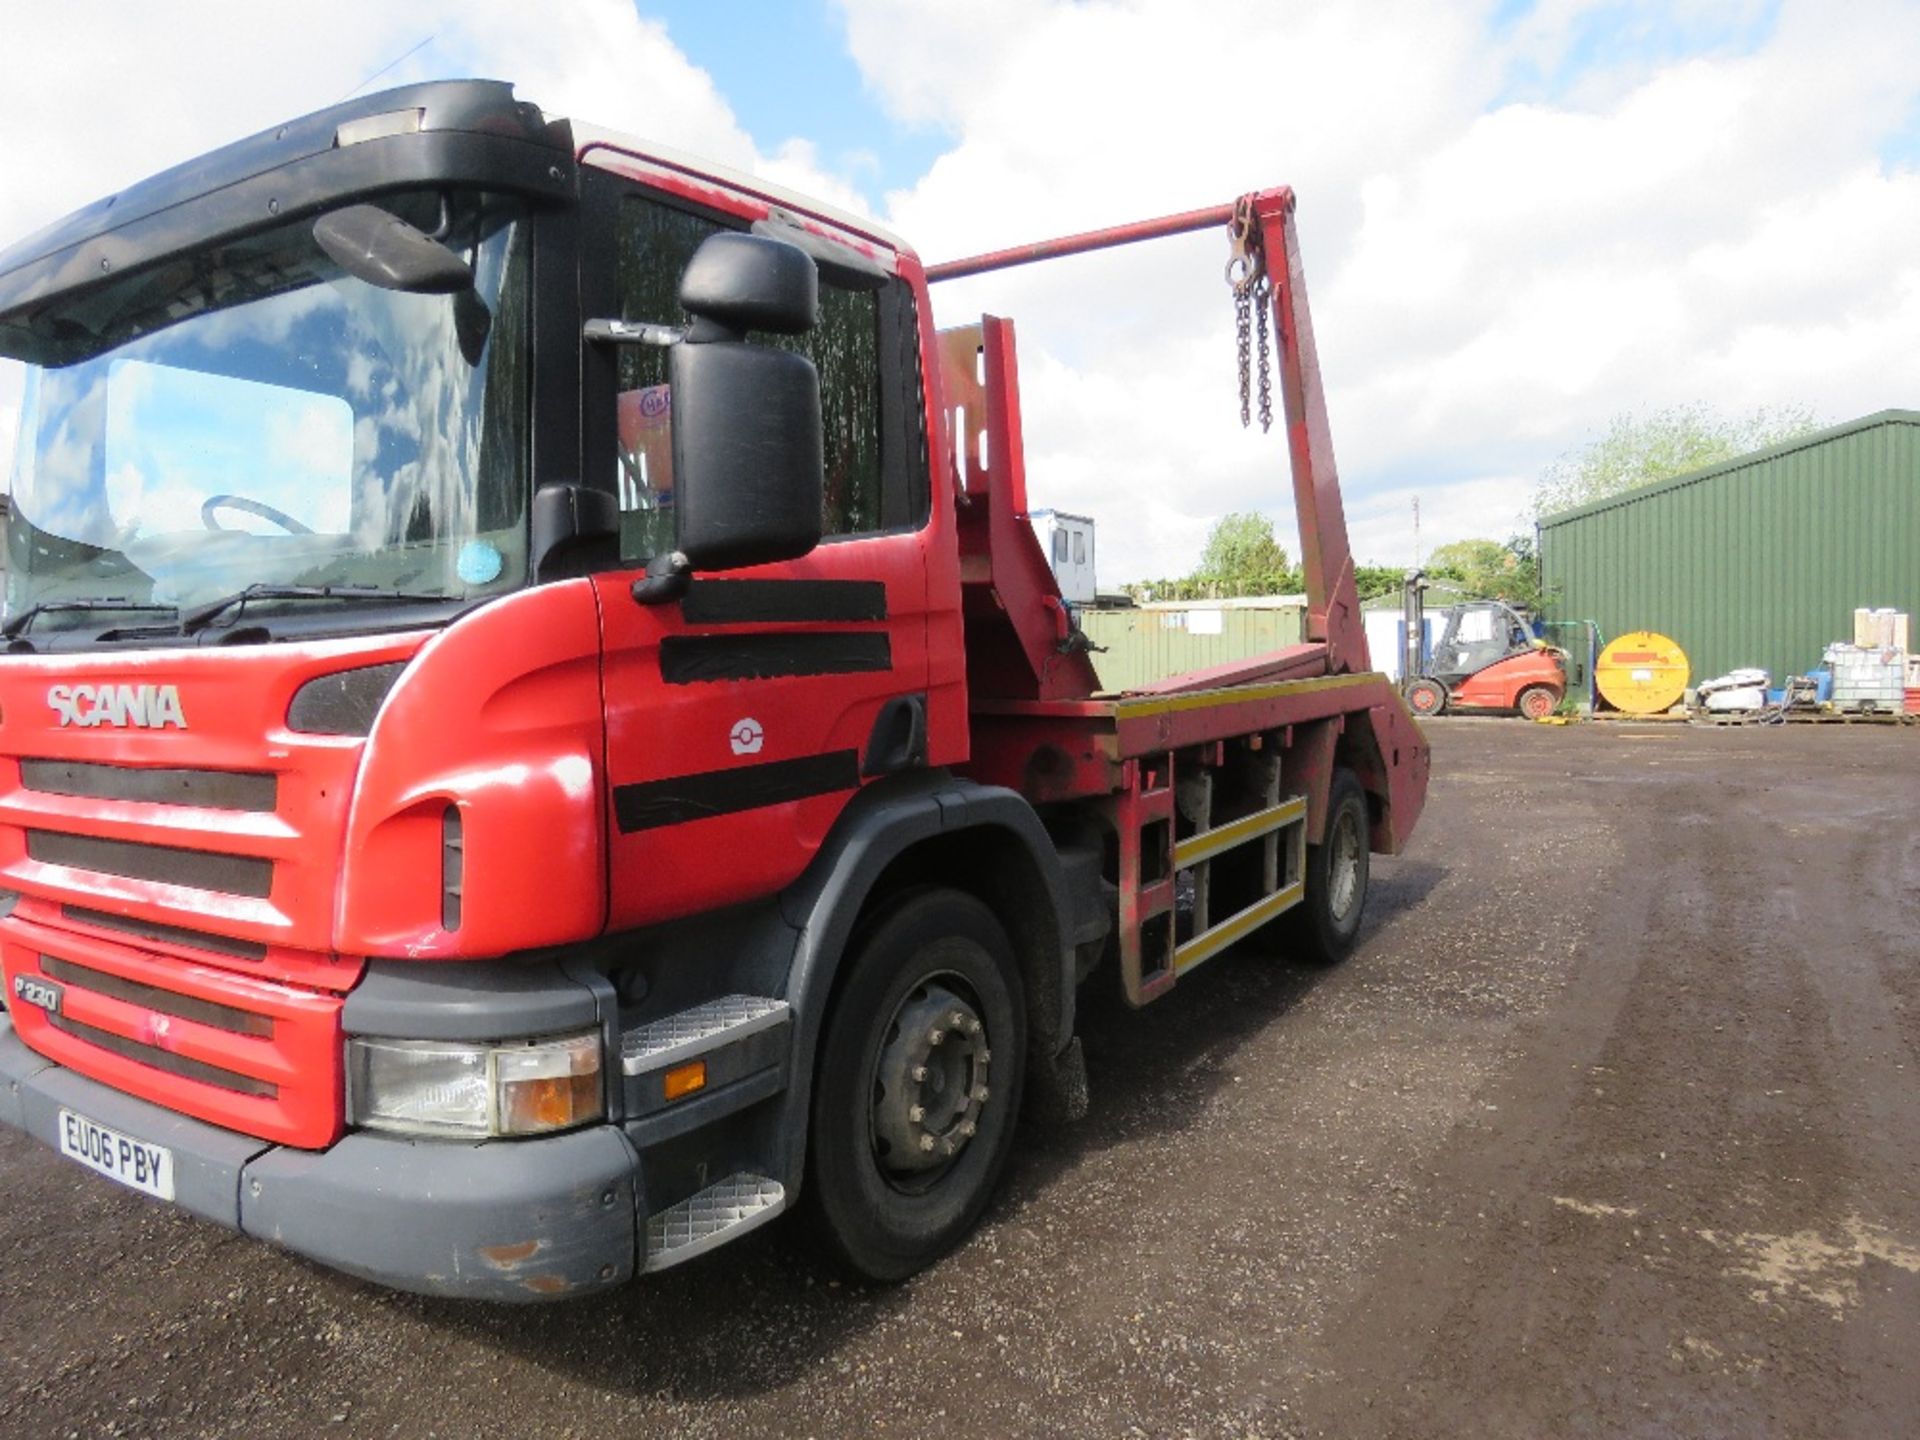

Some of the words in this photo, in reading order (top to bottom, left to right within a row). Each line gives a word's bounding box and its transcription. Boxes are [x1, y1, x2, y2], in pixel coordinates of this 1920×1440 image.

[47, 685, 187, 729] SCANIA
[66, 1116, 114, 1169] EU06
[118, 1140, 161, 1188] PBY
